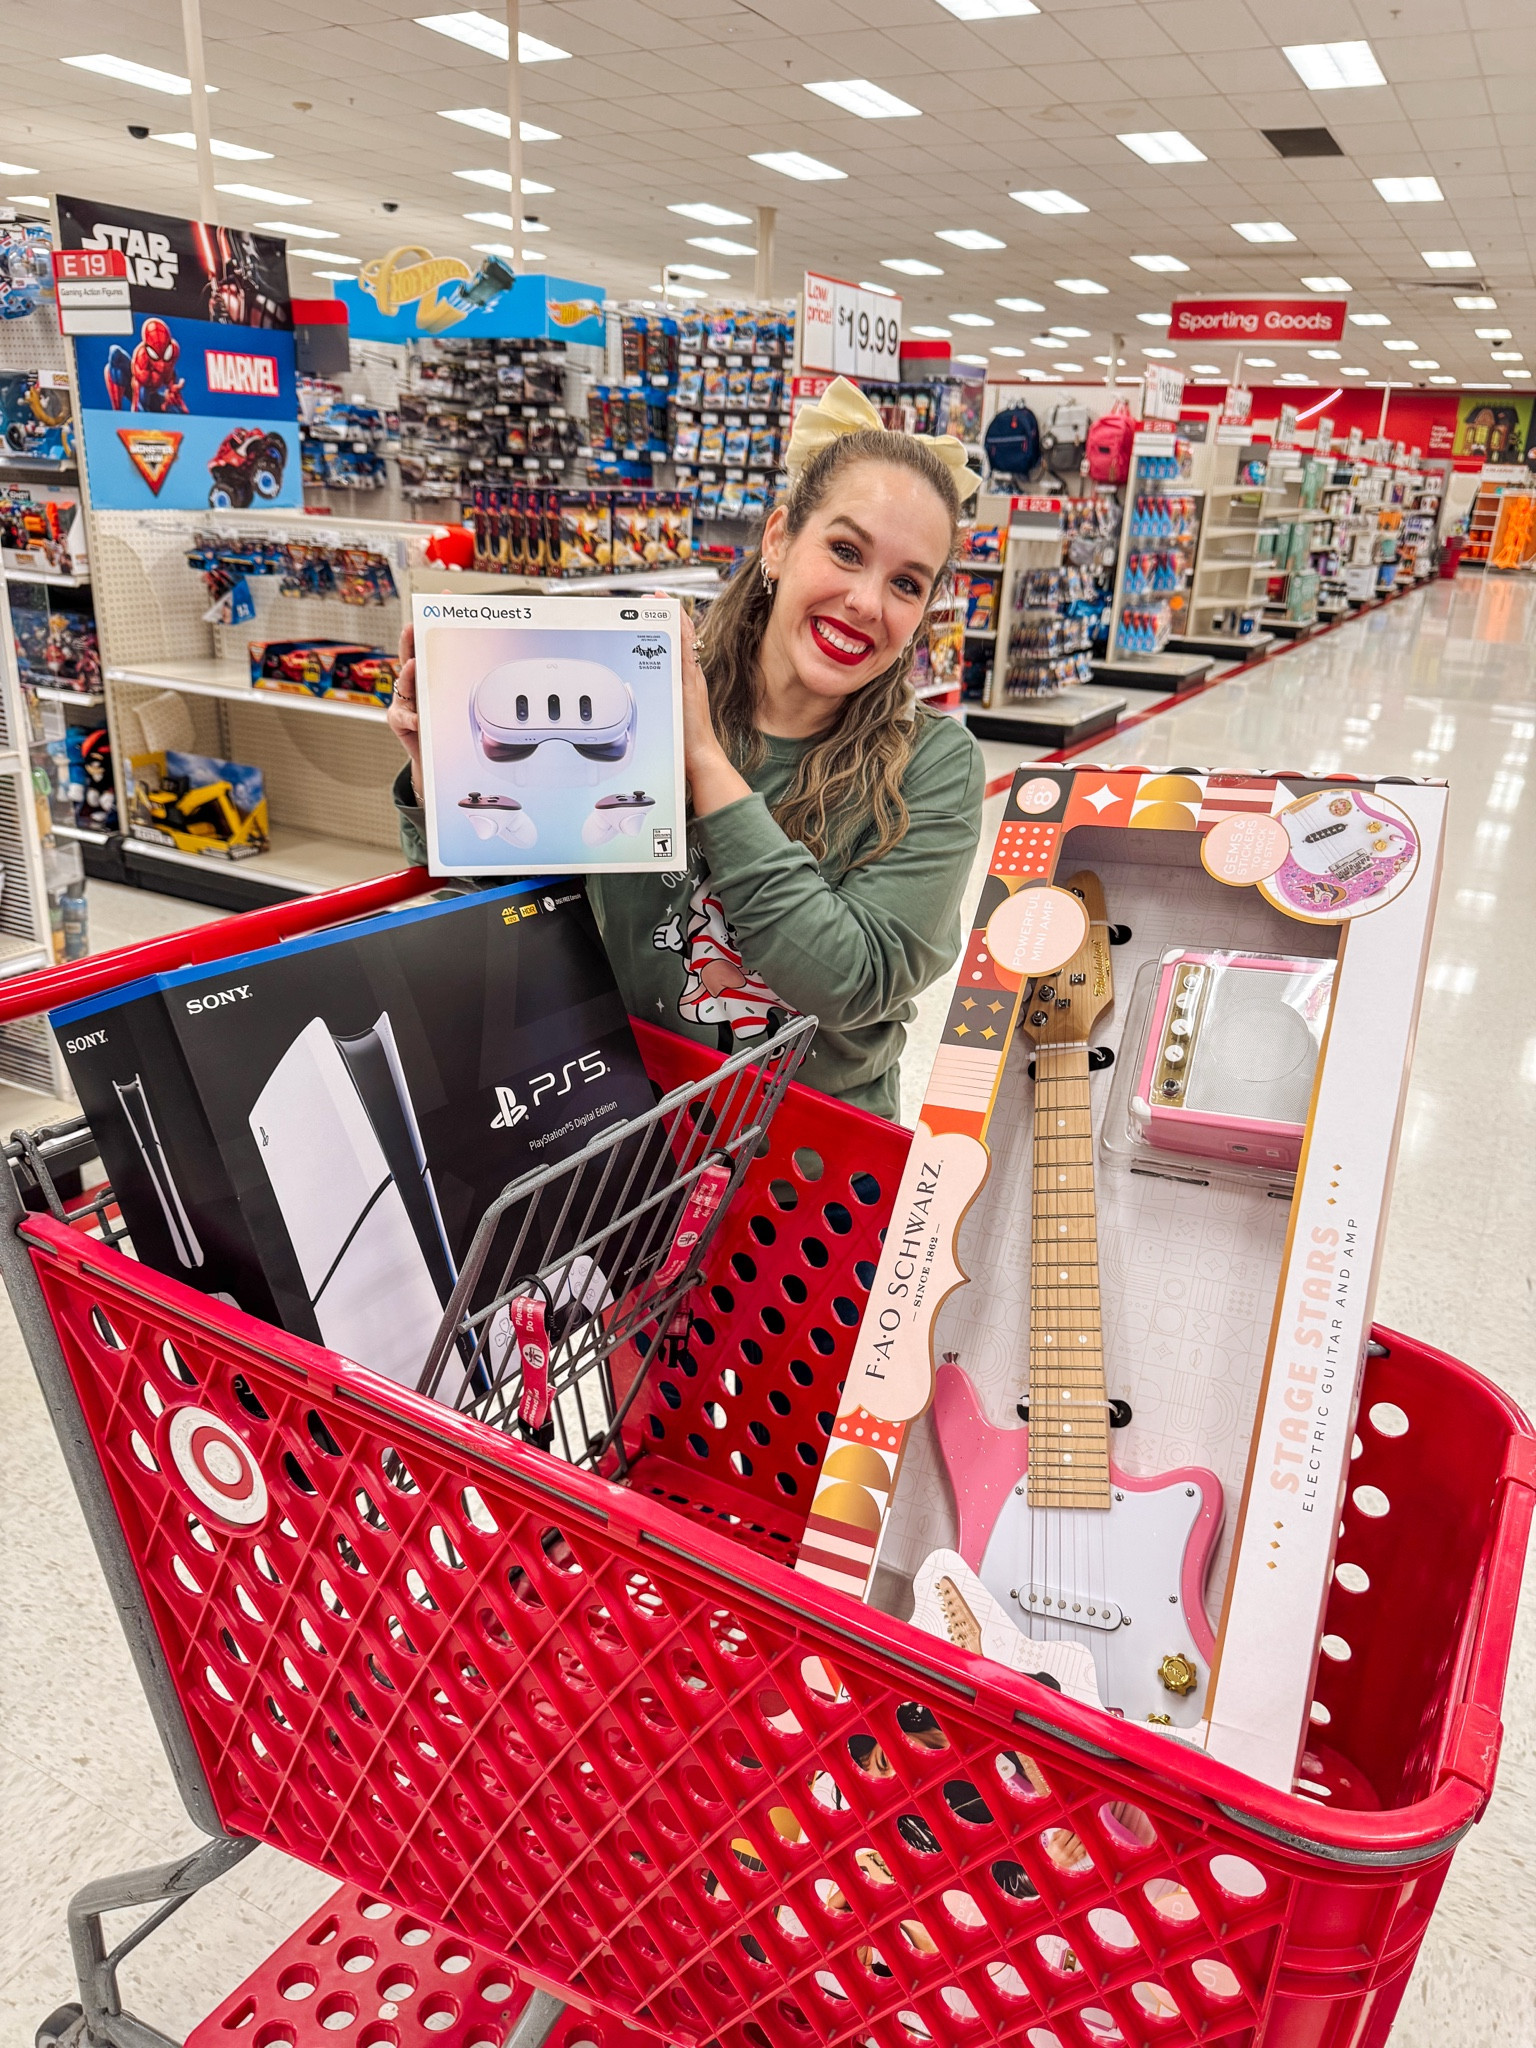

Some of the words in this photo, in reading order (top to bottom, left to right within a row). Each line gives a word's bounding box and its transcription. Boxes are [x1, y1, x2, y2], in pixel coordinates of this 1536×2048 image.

[81, 223, 178, 263] STAR
[63, 255, 78, 276] E
[80, 255, 106, 276] 19
[124, 256, 179, 290] RS
[60, 288, 82, 297] Gaming
[83, 288, 101, 297] Action
[101, 287, 123, 297] Figures
[807, 280, 829, 299] Low
[838, 304, 898, 356] $19.99
[1178, 311, 1259, 333] Sporting
[1264, 311, 1333, 330] Goods
[206, 352, 279, 395] MARVEL
[799, 381, 813, 398] E
[443, 606, 478, 618] Meta
[480, 606, 522, 620] Quest
[523, 608, 532, 619] 3
[624, 611, 635, 619] 4K
[1024, 784, 1036, 806] AGES
[656, 839, 669, 852] T
[1223, 832, 1244, 875] GEMS
[1234, 820, 1246, 830] &
[1237, 820, 1258, 876] STICKERS
[1255, 828, 1268, 856] ROCK
[1264, 829, 1278, 858] STYLE
[1251, 856, 1261, 868] TO
[1262, 859, 1272, 870] IN
[501, 905, 517, 917] 4K
[521, 905, 536, 915] HDR
[1013, 891, 1042, 967] POWERFUL
[1031, 934, 1045, 962] MINI
[1040, 899, 1056, 933] AMP
[186, 985, 251, 1015] SONY
[66, 1030, 107, 1054] SONY
[528, 1049, 608, 1107] PS5
[574, 1112, 595, 1129] Digital
[595, 1100, 618, 1118] Edition
[887, 1161, 942, 1299] SCHWARZ
[914, 1266, 931, 1308] SINCE
[925, 1236, 939, 1262] 1862
[1293, 1226, 1340, 1349] STARS
[515, 1298, 526, 1326] Please
[526, 1300, 536, 1318] not
[526, 1319, 535, 1332] Do
[1302, 1406, 1329, 1513] ELECTRIC
[1321, 1319, 1343, 1394] GUITAR
[1335, 1268, 1351, 1308] AND
[1343, 1218, 1358, 1258] AMP
[1270, 1361, 1319, 1495] STAGE
